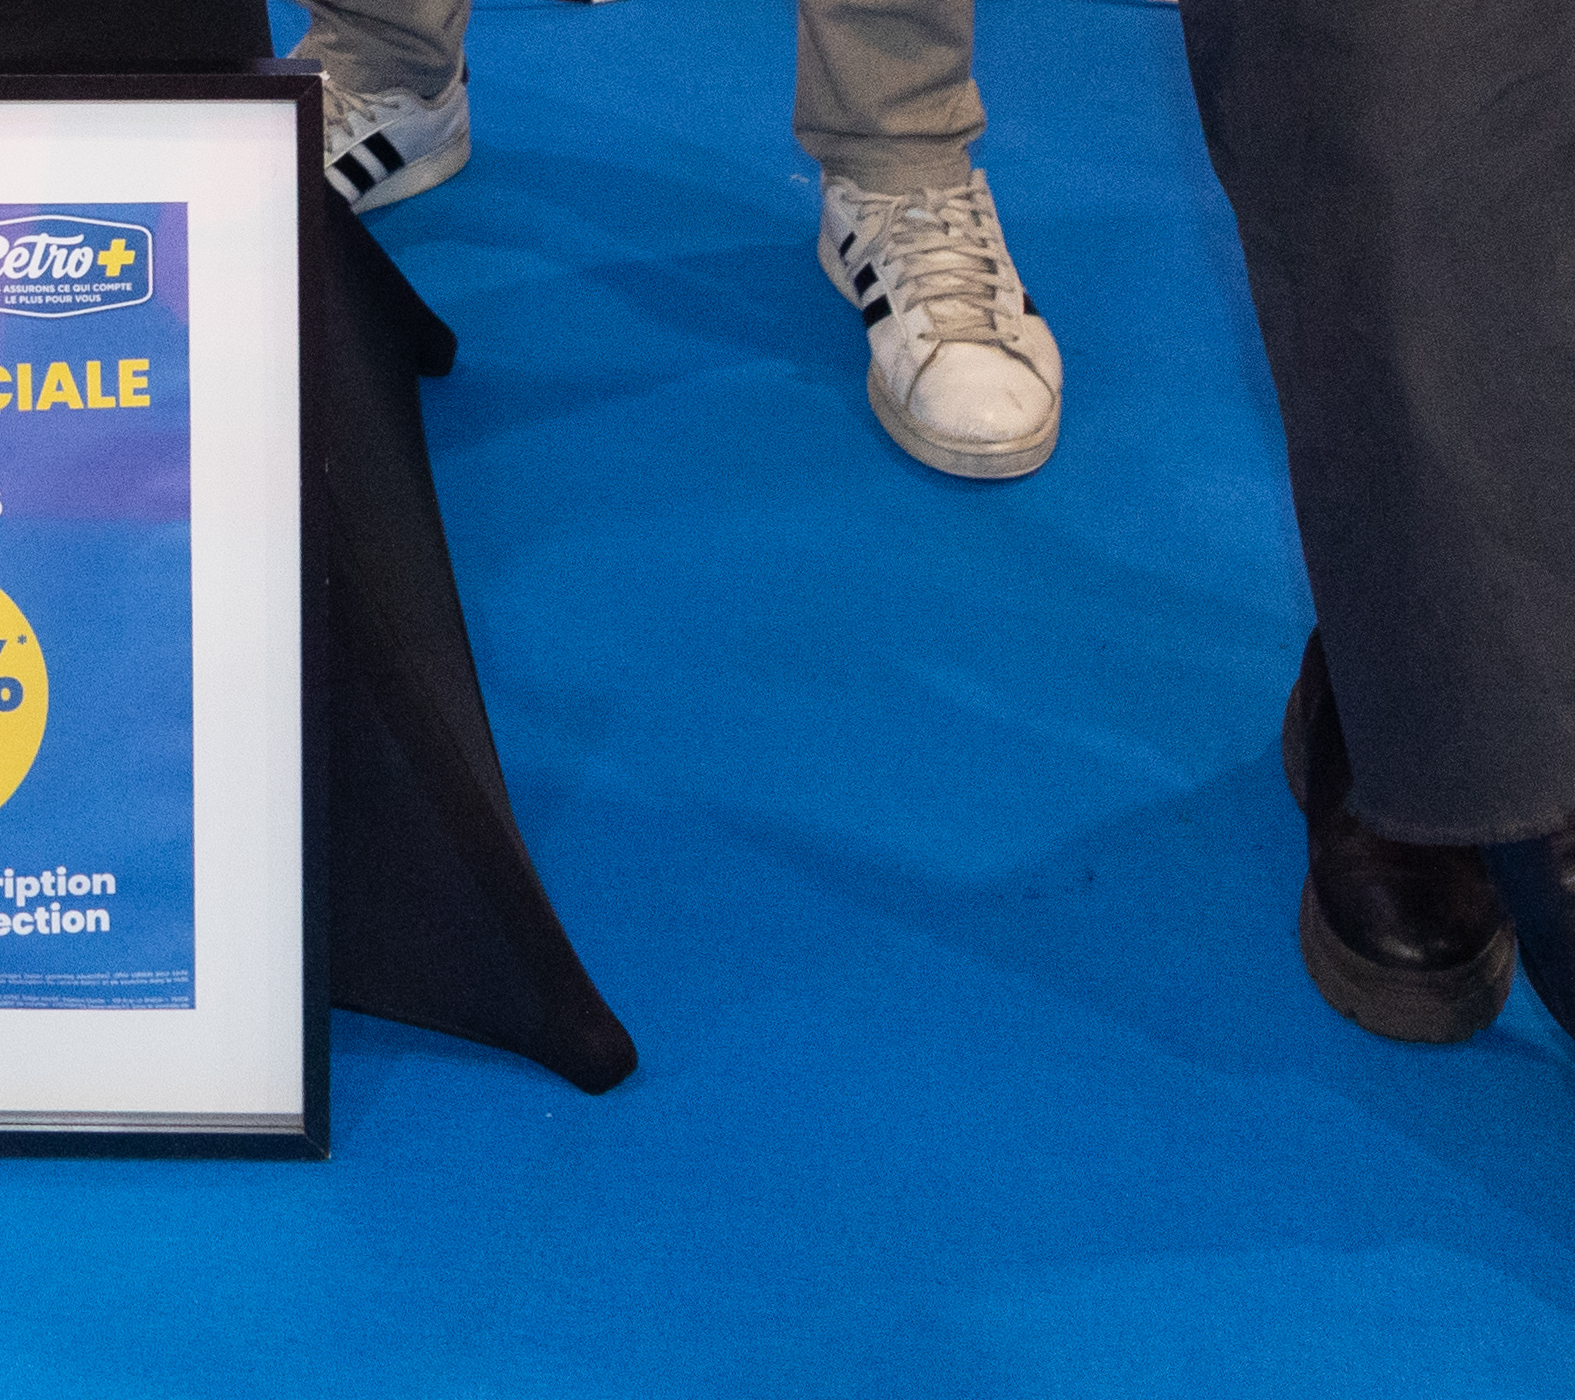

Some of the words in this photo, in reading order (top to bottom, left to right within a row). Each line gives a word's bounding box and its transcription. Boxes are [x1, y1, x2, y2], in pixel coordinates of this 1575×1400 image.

[3, 284, 55, 294] ASSURONS
[57, 284, 71, 293] CE
[72, 284, 91, 293] QUI
[92, 282, 133, 292] COMPTE
[5, 295, 17, 305] LE
[19, 294, 43, 304] PLUS
[45, 294, 73, 304] POUR
[76, 294, 102, 303] VOUS
